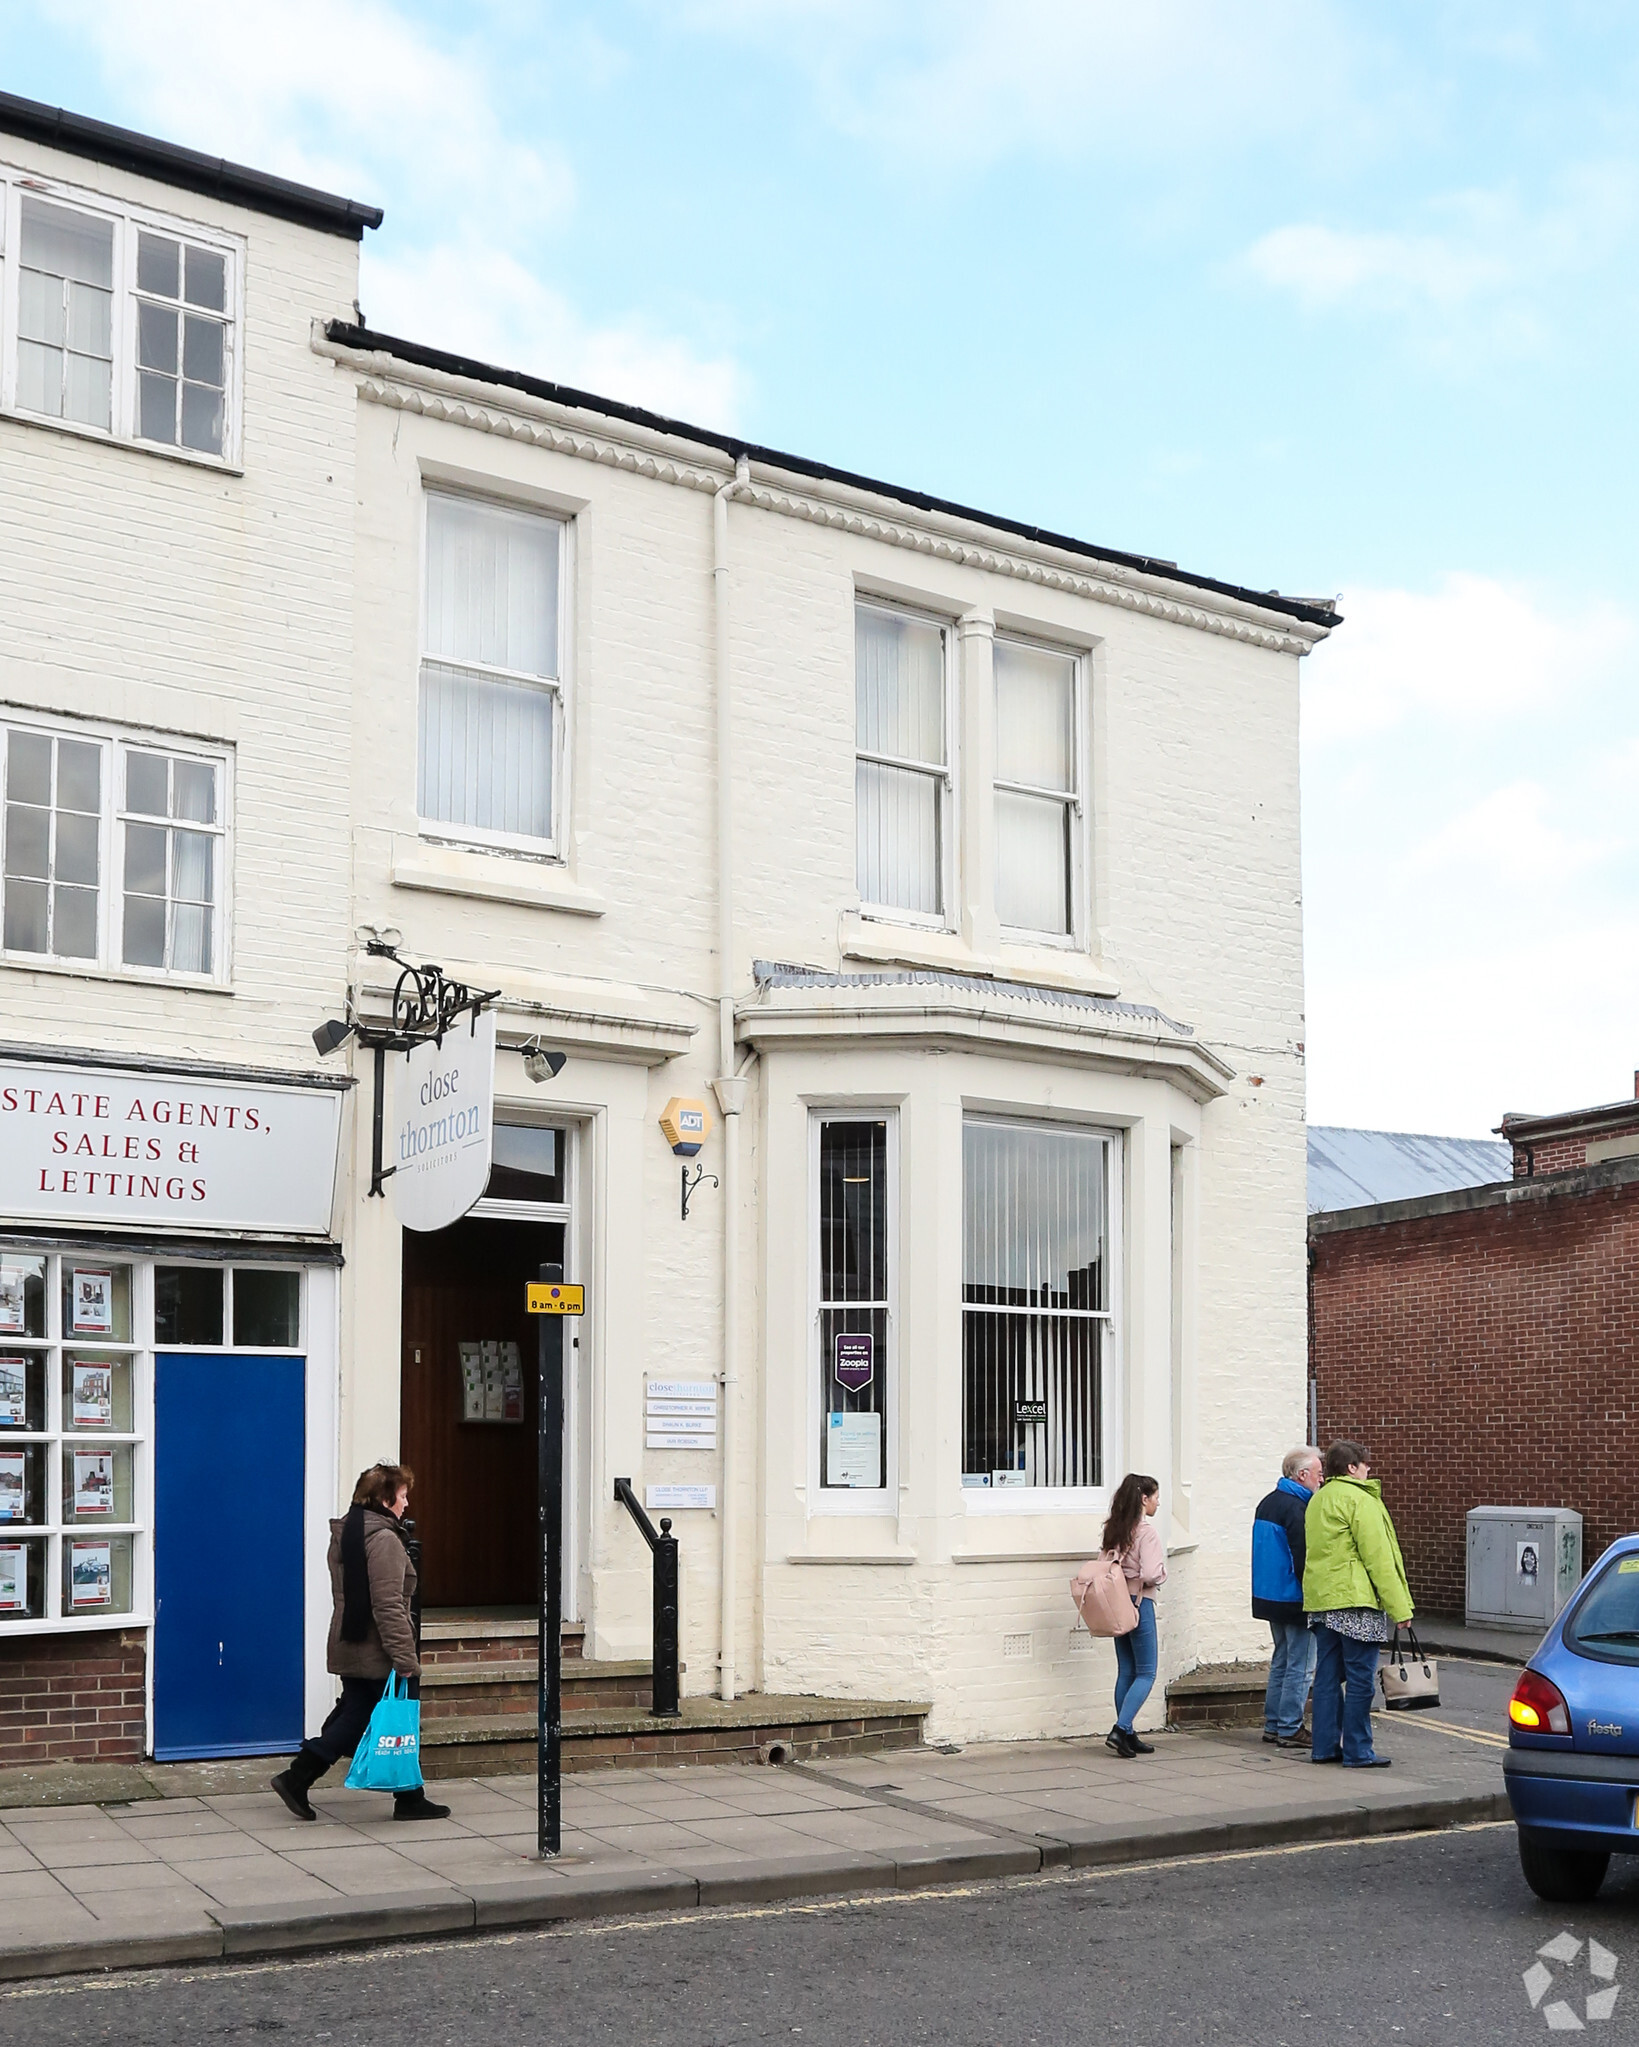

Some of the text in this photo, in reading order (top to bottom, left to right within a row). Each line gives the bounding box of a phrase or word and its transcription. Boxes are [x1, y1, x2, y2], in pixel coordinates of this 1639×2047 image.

[420, 1069, 460, 1106] close
[124, 1098, 272, 1135] AGENTS,
[680, 1114, 703, 1129] ADT
[399, 1104, 480, 1161] thornton
[52, 1131, 200, 1164] SALES &
[417, 1151, 458, 1174] SOLICITORS
[38, 1168, 207, 1202] LETTINGS
[531, 1300, 538, 1309] 8
[559, 1301, 566, 1310] 6
[567, 1303, 581, 1311] pm
[840, 1358, 869, 1368] Zoopla
[1016, 1402, 1047, 1414] Lexcel
